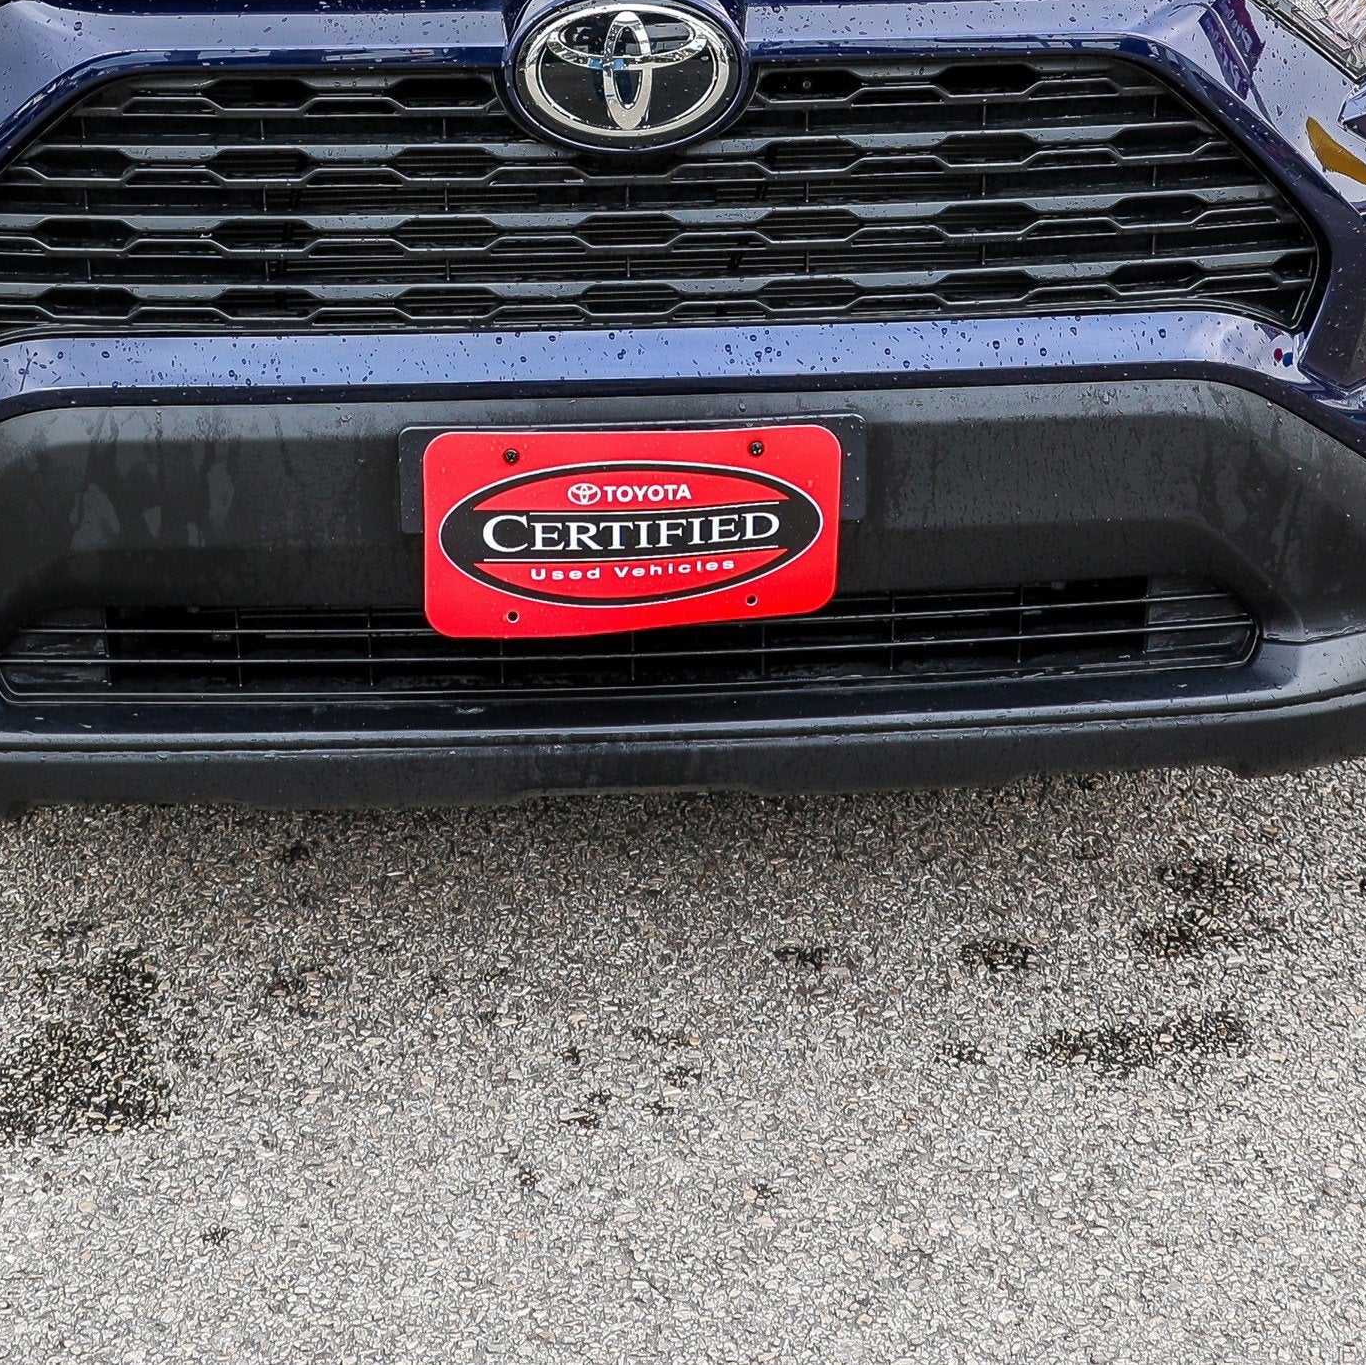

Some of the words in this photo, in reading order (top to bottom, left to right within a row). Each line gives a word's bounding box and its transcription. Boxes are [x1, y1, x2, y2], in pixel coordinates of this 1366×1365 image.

[602, 483, 692, 503] TOYOTA
[482, 511, 780, 553] CERTIFIED
[530, 566, 601, 581] Used
[613, 559, 736, 578] Vehicles
